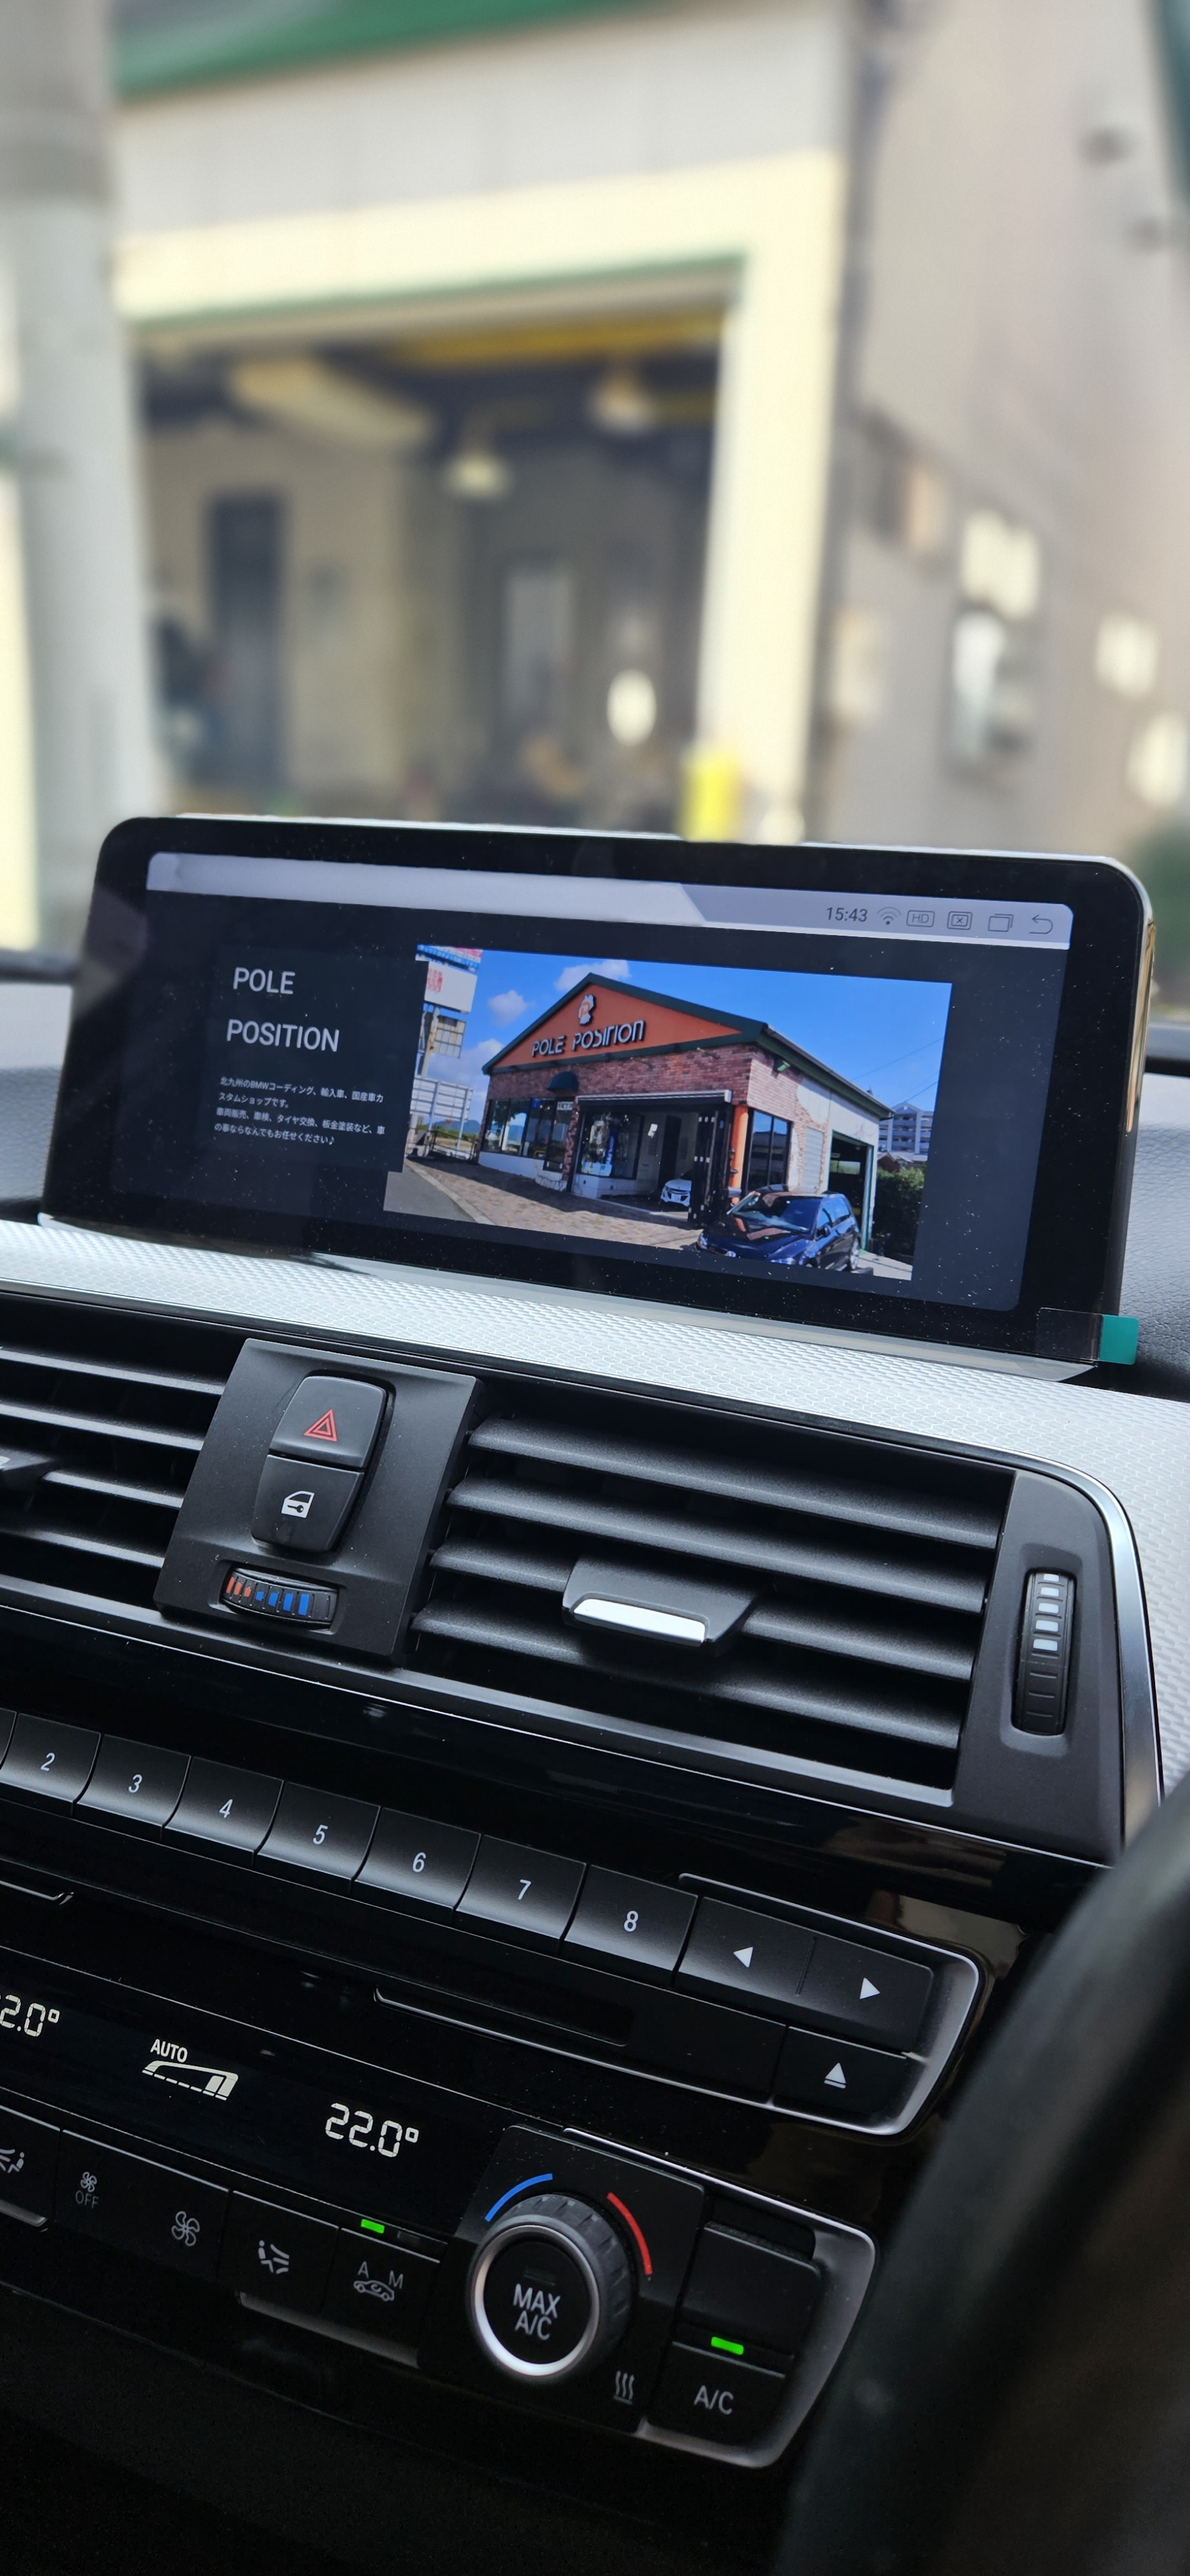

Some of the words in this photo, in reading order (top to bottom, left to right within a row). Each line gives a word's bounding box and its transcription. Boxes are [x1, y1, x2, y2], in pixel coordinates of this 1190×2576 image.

[826, 907, 868, 922] 15:43
[911, 913, 930, 924] HD
[233, 967, 296, 994] POLE
[227, 1019, 340, 1052] POSITION
[531, 1035, 565, 1057] POLE
[572, 1019, 645, 1052] POSITION
[218, 1092, 289, 1108] スタムショップです。
[41, 1752, 55, 1772] 2
[128, 1774, 142, 1794] 3
[219, 1799, 233, 1818] 4
[312, 1824, 328, 1845] 5
[412, 1852, 426, 1872] 6
[518, 1879, 531, 1900] 7
[623, 1911, 639, 1932] 8
[150, 2038, 188, 2063] AUTO
[75, 2190, 99, 2209] OFF
[357, 2260, 369, 2278] A
[389, 2270, 404, 2289] M
[513, 2283, 561, 2318] MAX
[515, 2315, 552, 2341] A/C
[694, 2385, 734, 2415] A/C
